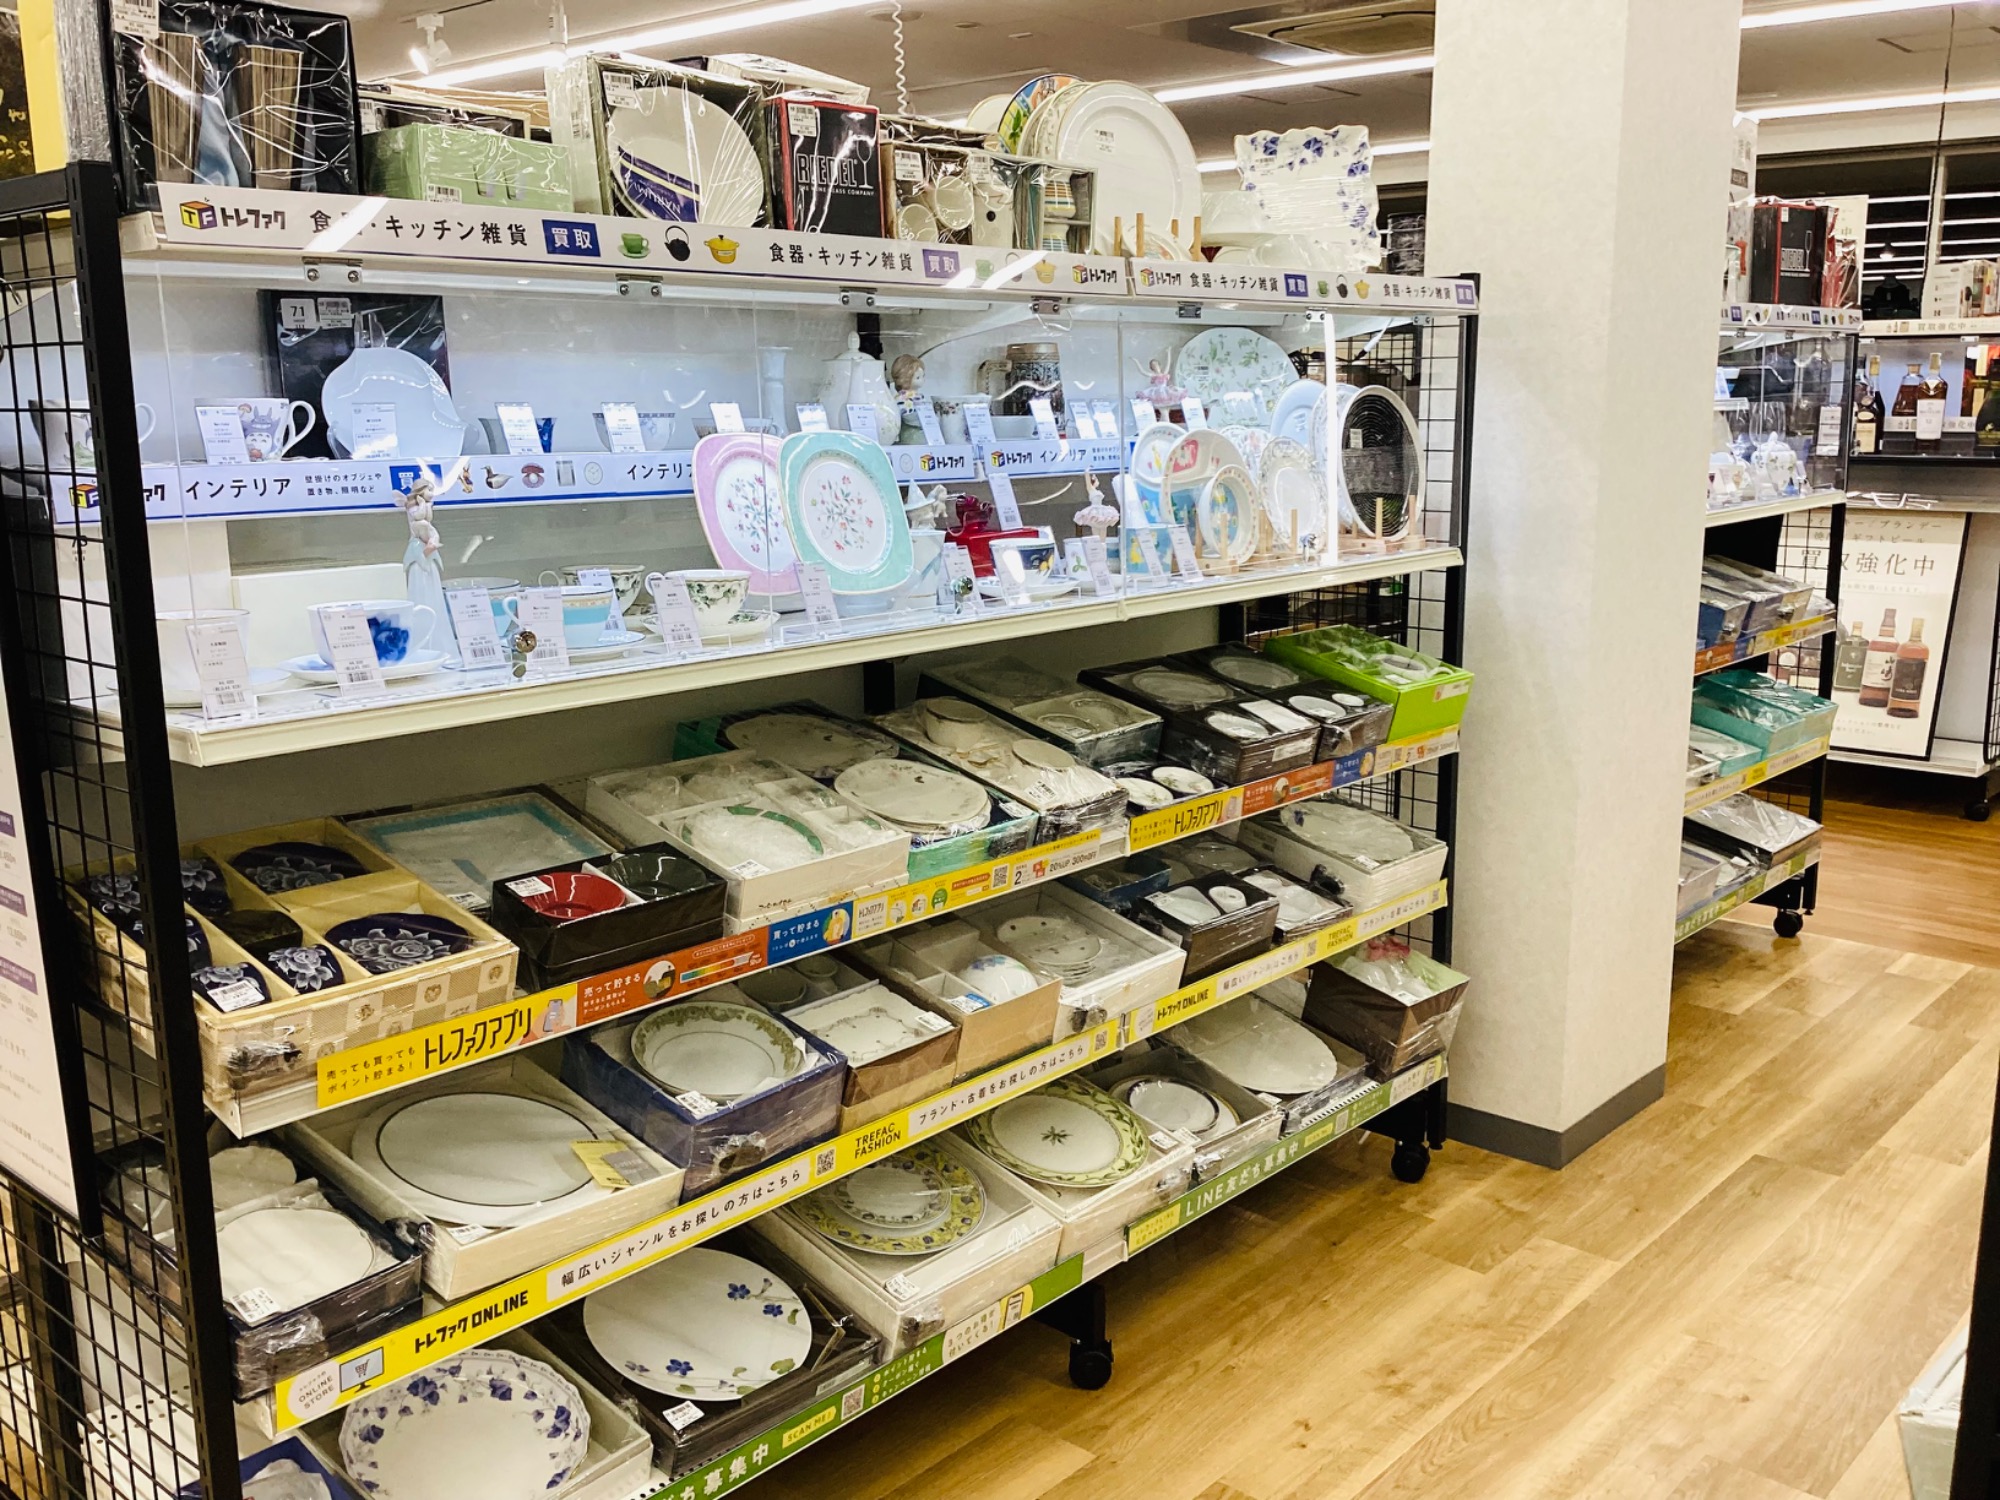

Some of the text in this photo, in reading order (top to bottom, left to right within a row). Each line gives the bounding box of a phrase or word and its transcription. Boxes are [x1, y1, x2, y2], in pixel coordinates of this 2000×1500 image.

[848, 189, 875, 197] COMPANY
[220, 207, 286, 230] トレファク
[310, 209, 528, 246] 食・キッチン雑貨
[551, 227, 593, 250] 買取
[769, 242, 912, 272] 食器・キッチン雑貨
[928, 255, 960, 274] 買取
[1089, 268, 1117, 283] トレファク
[1156, 272, 1181, 286] トレファク
[1190, 272, 1279, 292] 食器・キッチン雑貨
[290, 305, 305, 317] 71
[937, 455, 964, 468] トレファク
[1006, 451, 1032, 465] トレファク
[186, 477, 292, 501] インテリア
[304, 473, 382, 484] 壁掛けのオブジェや
[306, 485, 376, 496] 置き物、照明など
[1174, 800, 1224, 834] トレファクアプリ
[1014, 871, 1023, 886] 2
[773, 919, 820, 940] 買って貯まる
[584, 972, 641, 998] 売って貯まる
[1182, 988, 1209, 1010] ONLINE
[425, 1008, 532, 1070] トレファクアプリ
[326, 1046, 415, 1080] 売っても買っても
[919, 1044, 1084, 1126] ブランド・古着をお探しの方はこちら
[854, 1130, 901, 1160] FASHION
[855, 1122, 896, 1148] TREFAC
[1186, 1140, 1299, 1217] LINE友だち募集中
[561, 1169, 801, 1287] 幅広いジャンルをお探しの方はこちら
[415, 1290, 529, 1354] トレファク ONLINE
[299, 1374, 334, 1403] ONLINE
[304, 1384, 335, 1410] STORE
[787, 1424, 811, 1443] SCAN
